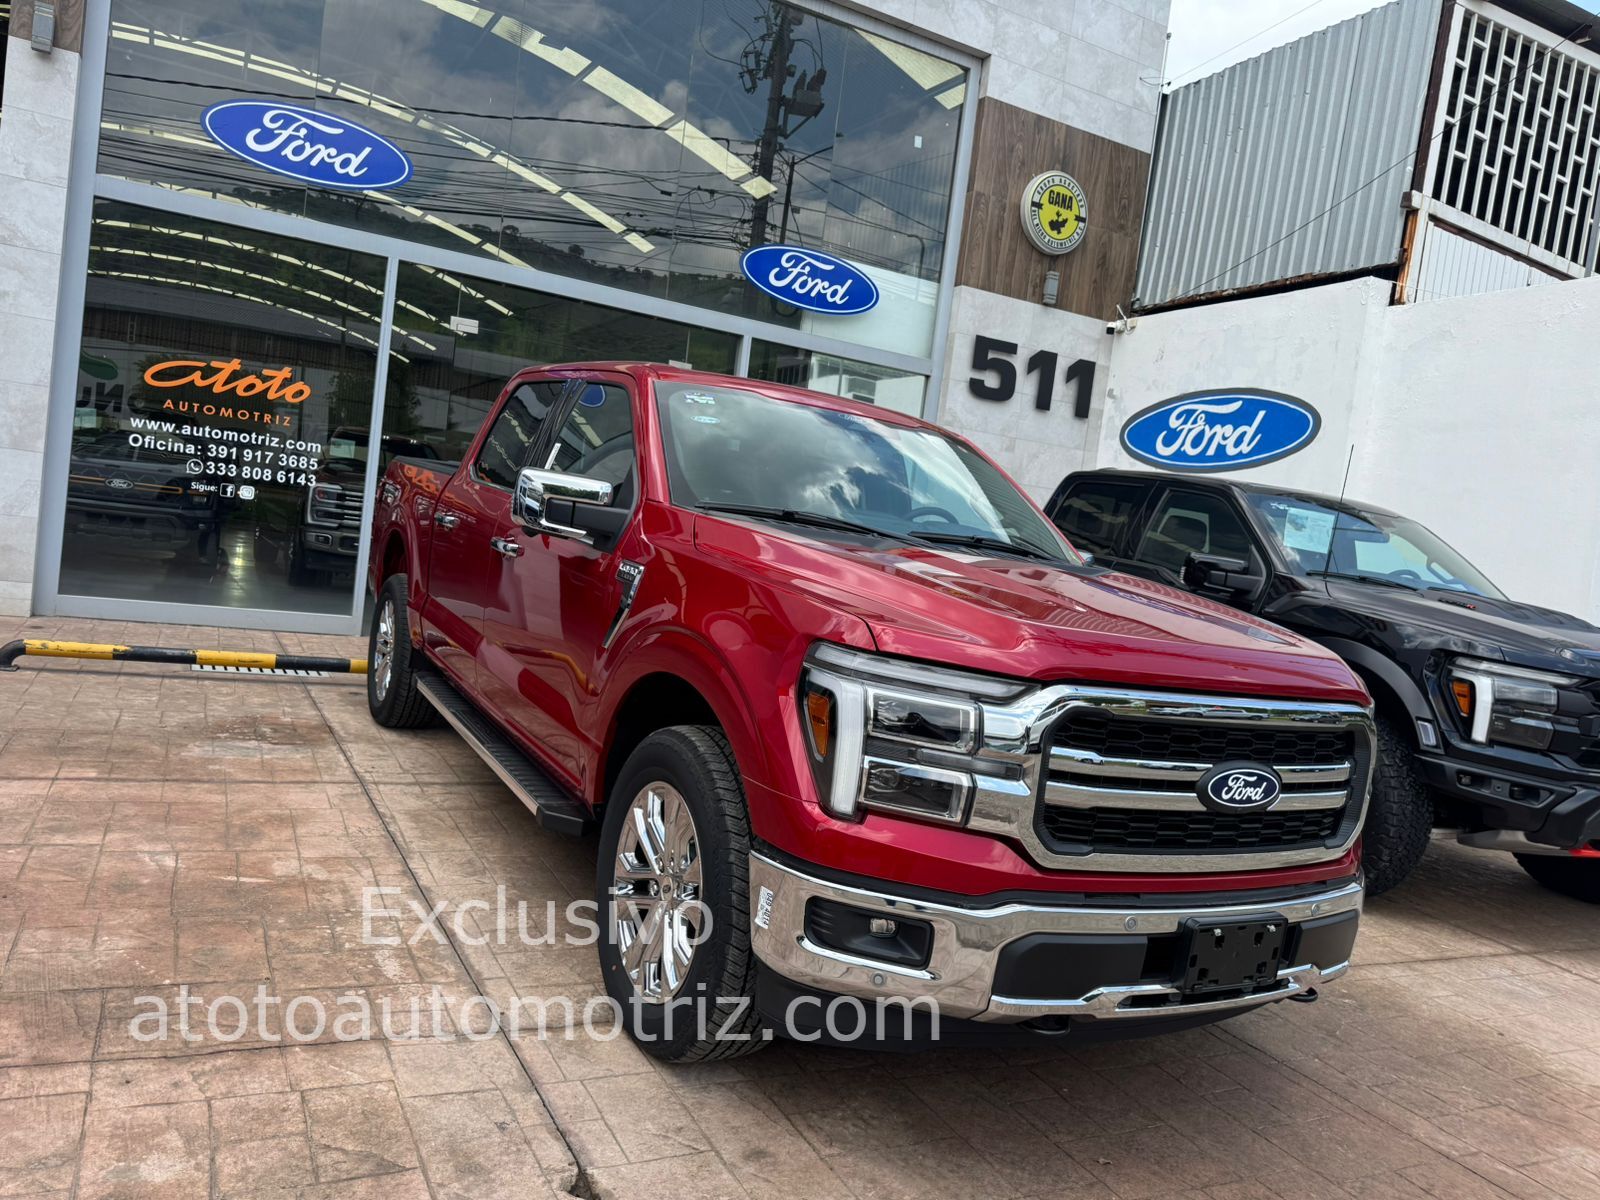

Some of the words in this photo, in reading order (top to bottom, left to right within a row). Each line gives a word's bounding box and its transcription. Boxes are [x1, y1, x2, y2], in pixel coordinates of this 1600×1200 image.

[245, 109, 373, 177] Ford
[1048, 189, 1073, 212] GANA
[768, 251, 853, 305] Ford
[143, 358, 312, 404] atoto
[969, 334, 1096, 419] 511
[162, 399, 292, 427] AUTOMOTRIZ
[1156, 400, 1267, 456] Ford
[128, 433, 202, 455] Oficina:
[207, 444, 237, 460] 391
[243, 449, 274, 464] 917
[278, 454, 318, 470] 3685
[130, 416, 322, 454] www.automotriz.com
[190, 481, 218, 492] Sigue:
[205, 461, 237, 477] 333
[241, 467, 272, 481] 808
[276, 472, 317, 487] 6143
[1221, 774, 1267, 801] Ford
